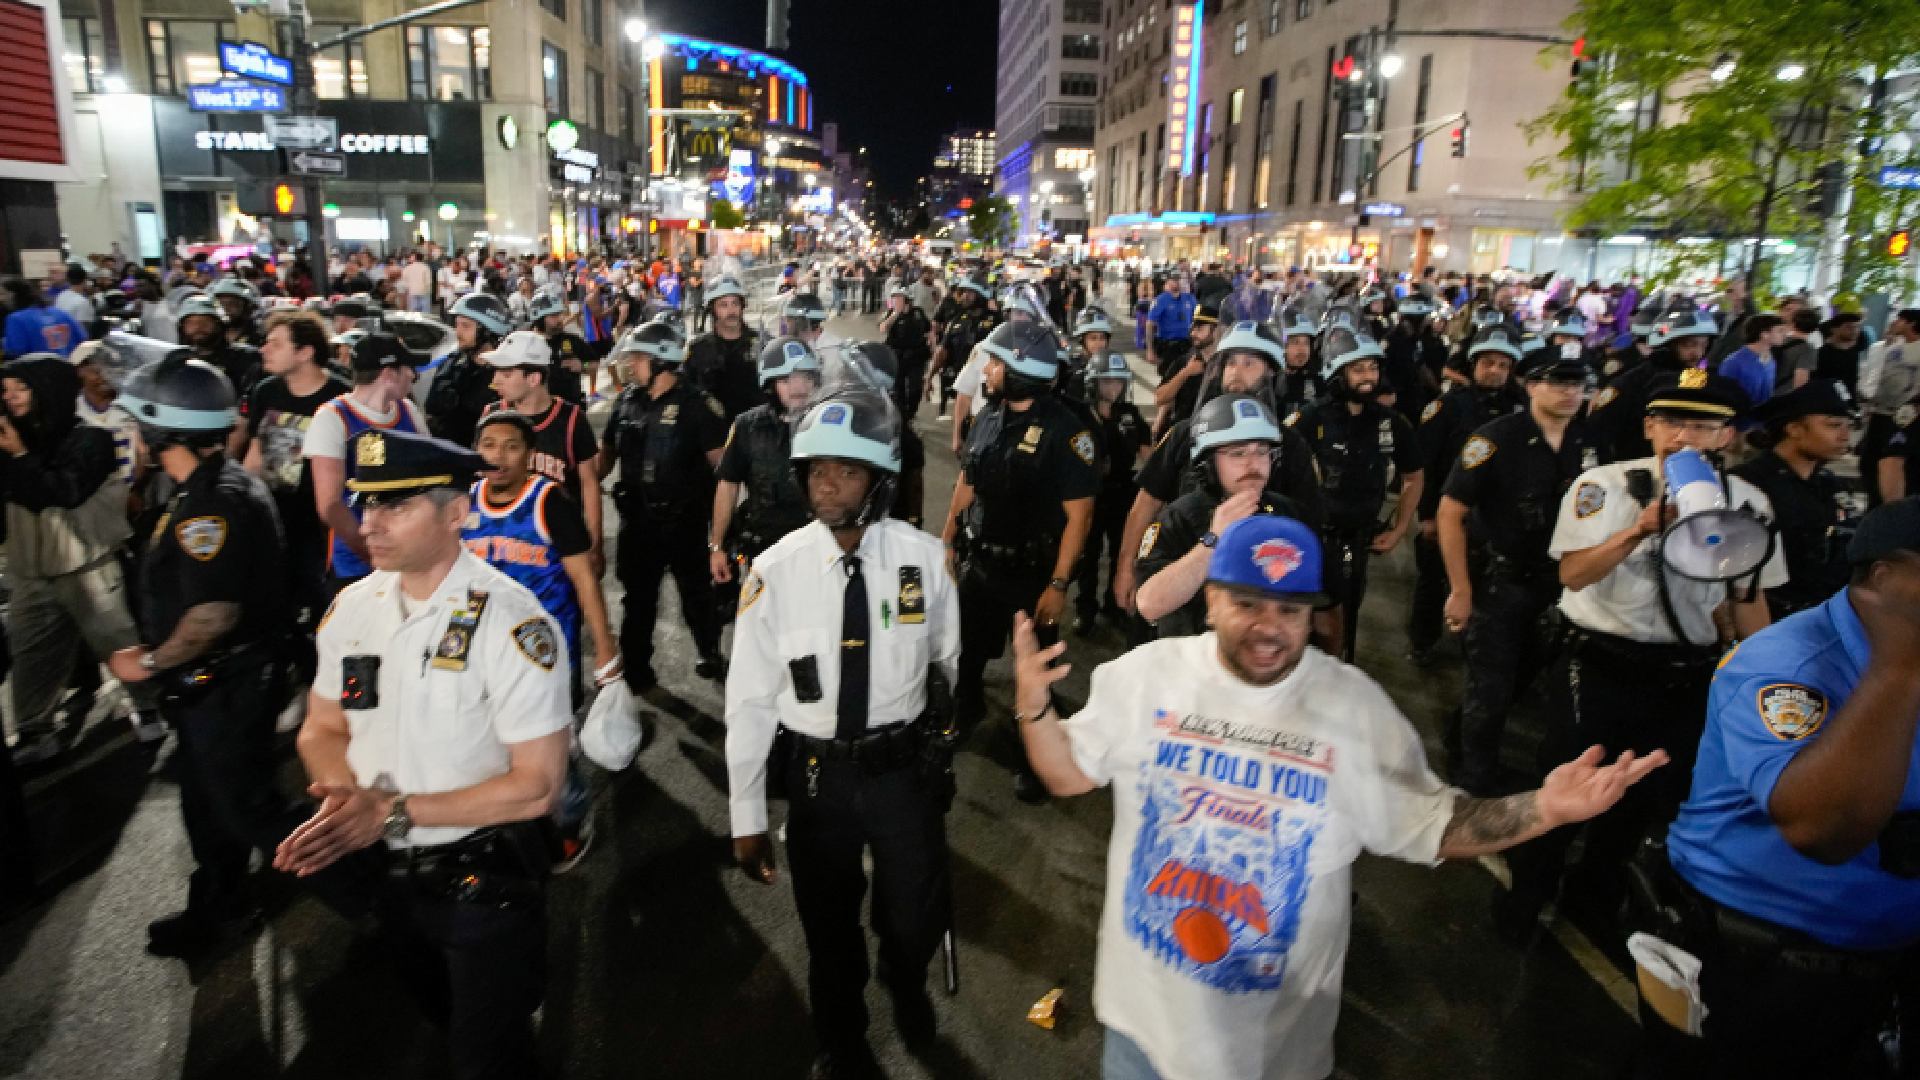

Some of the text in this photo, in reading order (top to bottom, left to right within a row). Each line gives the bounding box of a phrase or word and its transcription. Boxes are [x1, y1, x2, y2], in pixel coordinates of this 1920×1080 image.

[193, 88, 232, 107] West
[262, 88, 279, 107] St
[1168, 7, 1194, 168] NEW YORKER
[340, 133, 428, 154] COFFEE
[492, 536, 549, 568] YORK
[1156, 740, 1194, 772] WE
[1198, 747, 1262, 791] TOLD
[1169, 785, 1270, 833] Finals
[1146, 858, 1270, 937] KNICKS
